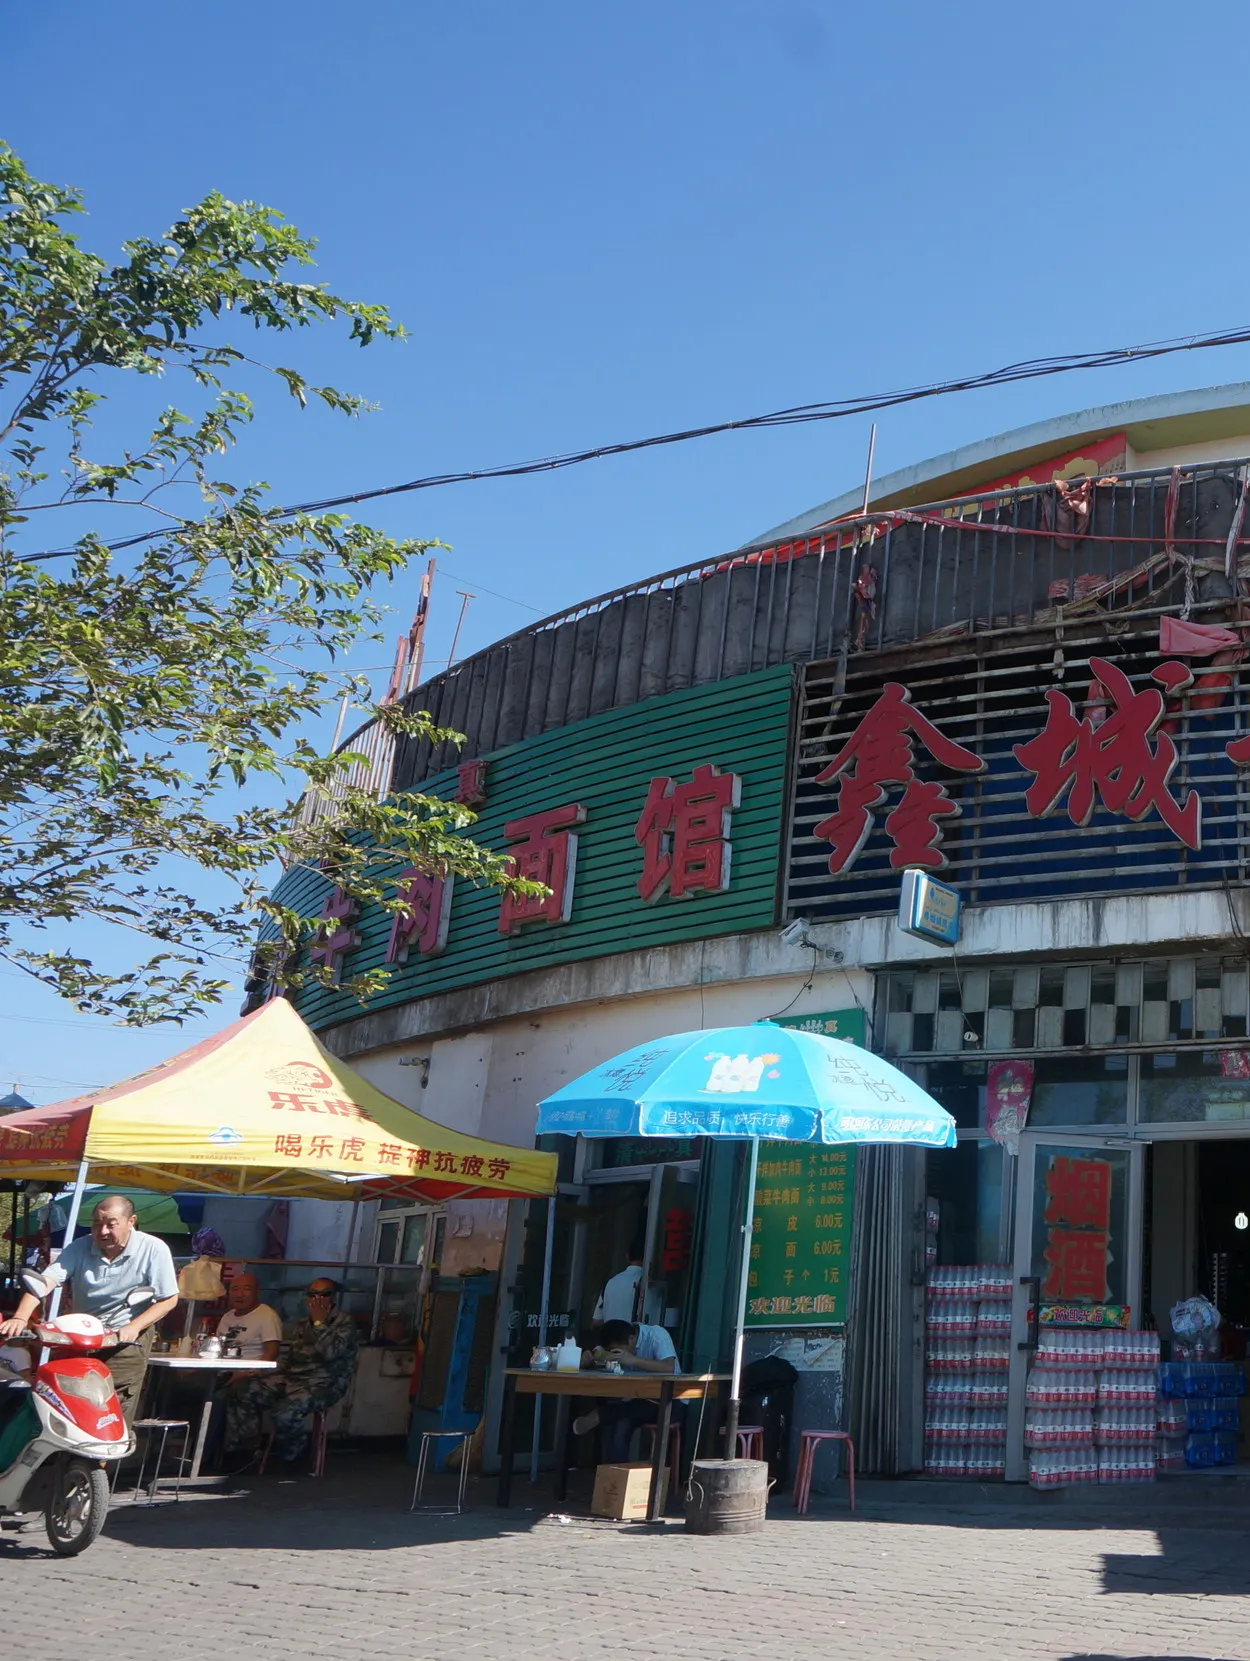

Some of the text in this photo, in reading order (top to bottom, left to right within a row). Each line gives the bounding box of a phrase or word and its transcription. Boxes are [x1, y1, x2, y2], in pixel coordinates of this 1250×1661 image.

[267, 1090, 380, 1125] 乐虎
[663, 1110, 791, 1128] 追求品质 快乐行善
[275, 1132, 512, 1181] 喝乐虎 提神抗疲劳
[815, 1213, 843, 1229] 6.00元
[1042, 1155, 1113, 1302] 烟酒
[813, 1239, 842, 1256] 6.00元
[748, 1294, 836, 1316] 欢迎光临
[527, 1313, 570, 1328] 欢光临
